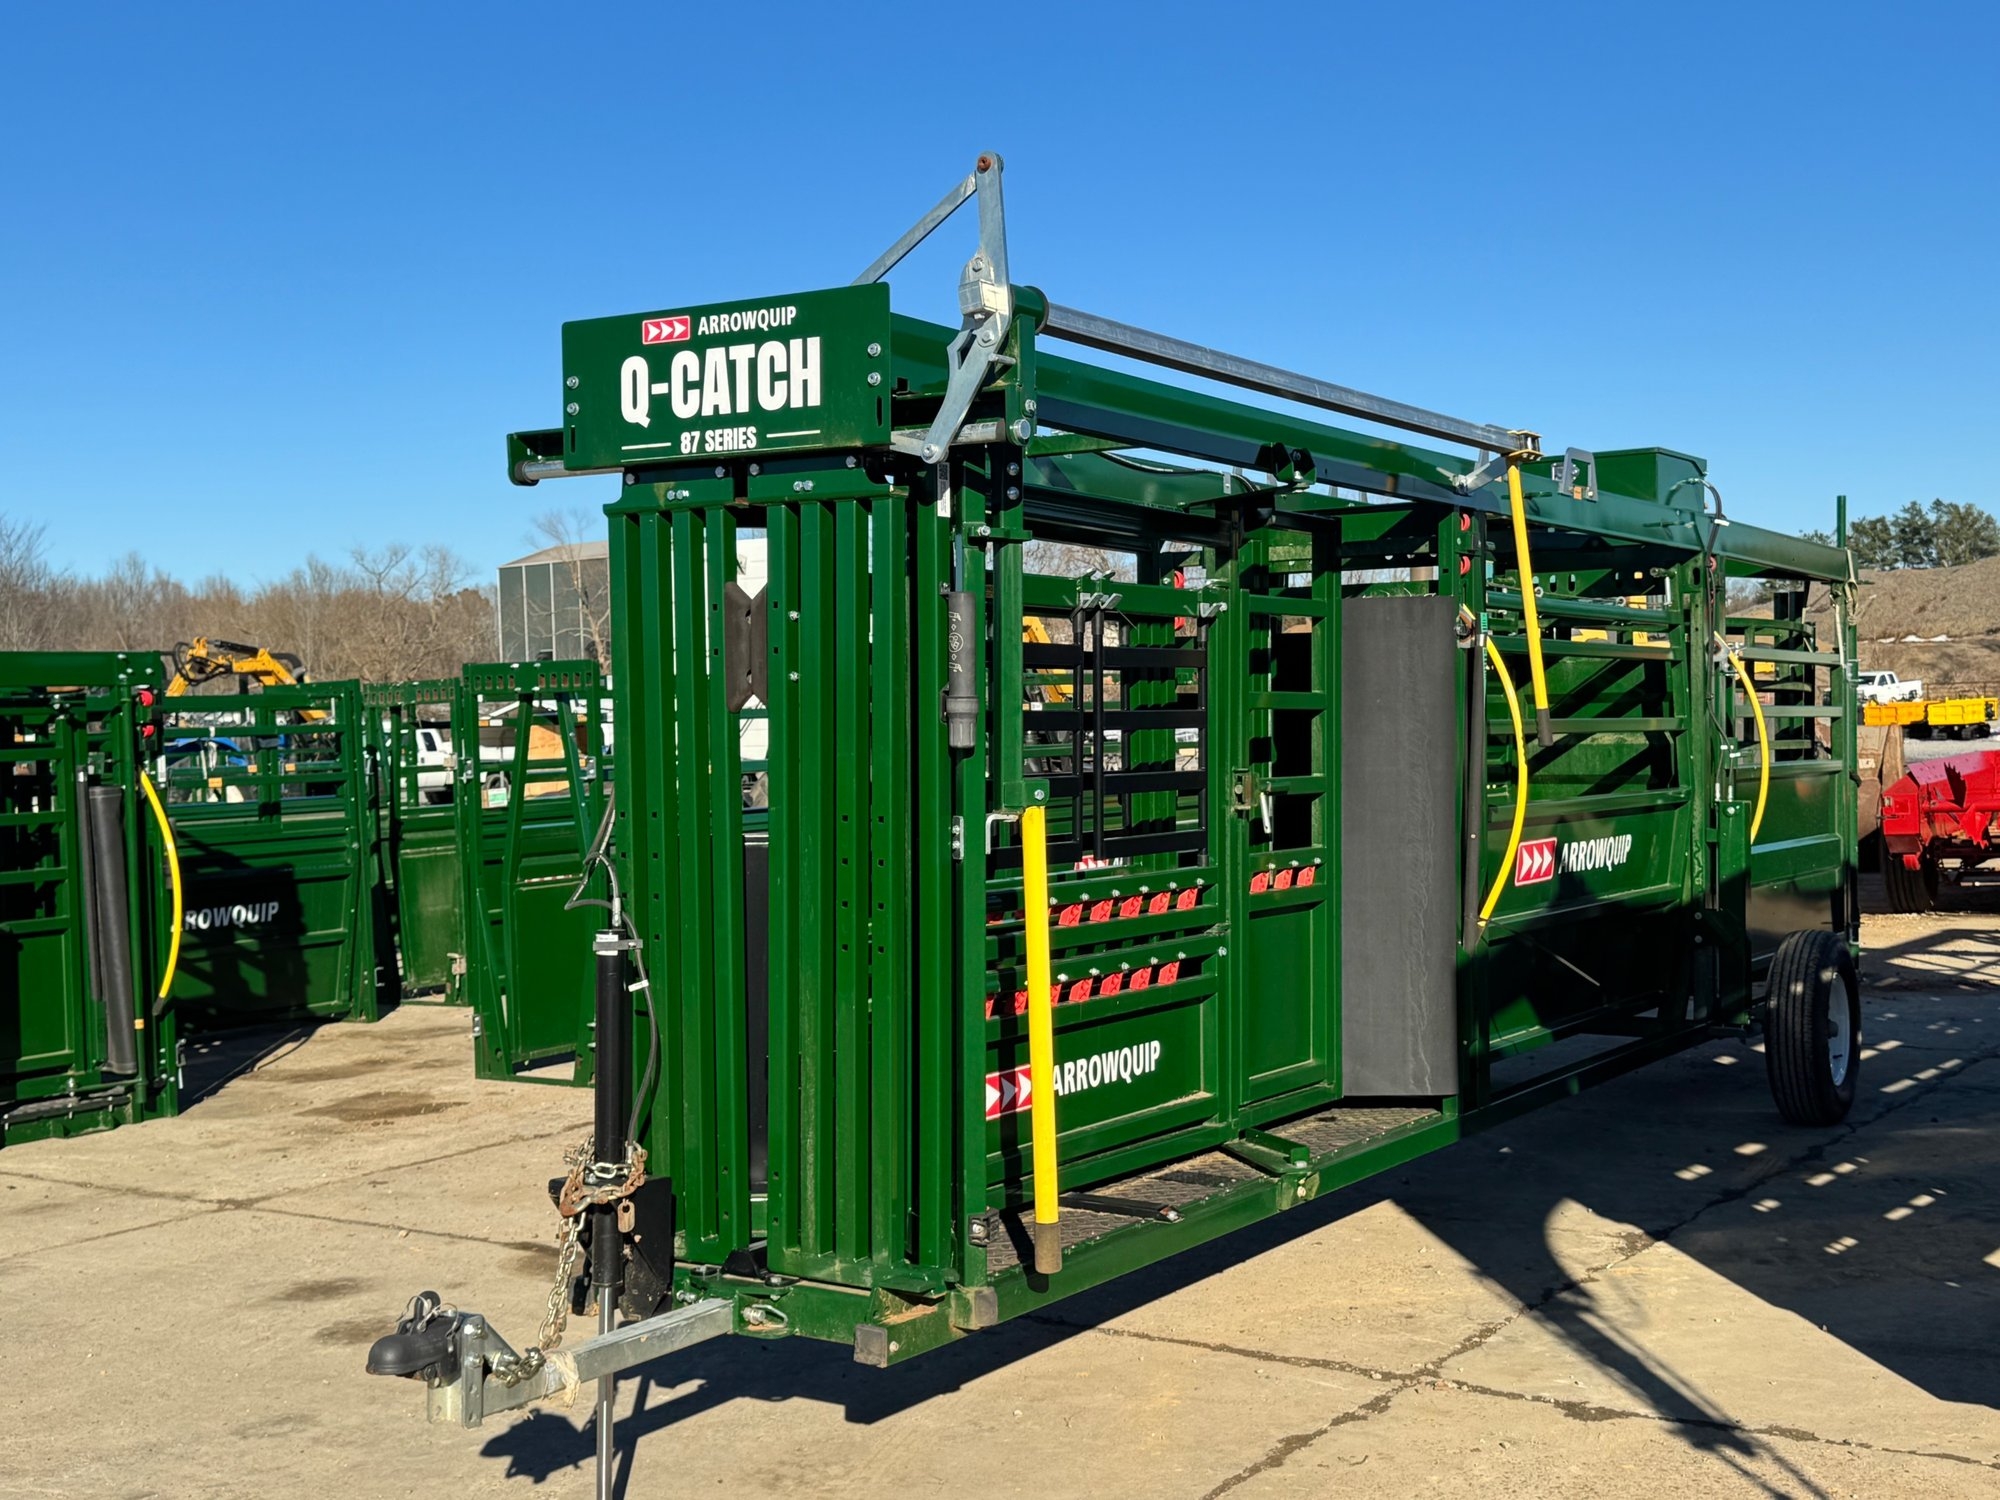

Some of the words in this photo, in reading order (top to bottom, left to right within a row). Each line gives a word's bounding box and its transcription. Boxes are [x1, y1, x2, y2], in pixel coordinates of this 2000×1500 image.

[698, 306, 797, 335] ARROWQUIP
[621, 337, 821, 428] Q-CATCH
[680, 431, 700, 454] 87
[705, 427, 757, 452] SERIES
[1558, 834, 1632, 874] ARROWQUIP
[170, 902, 279, 933] ROWQUIP
[1053, 1040, 1160, 1096] ARROWQUIP
